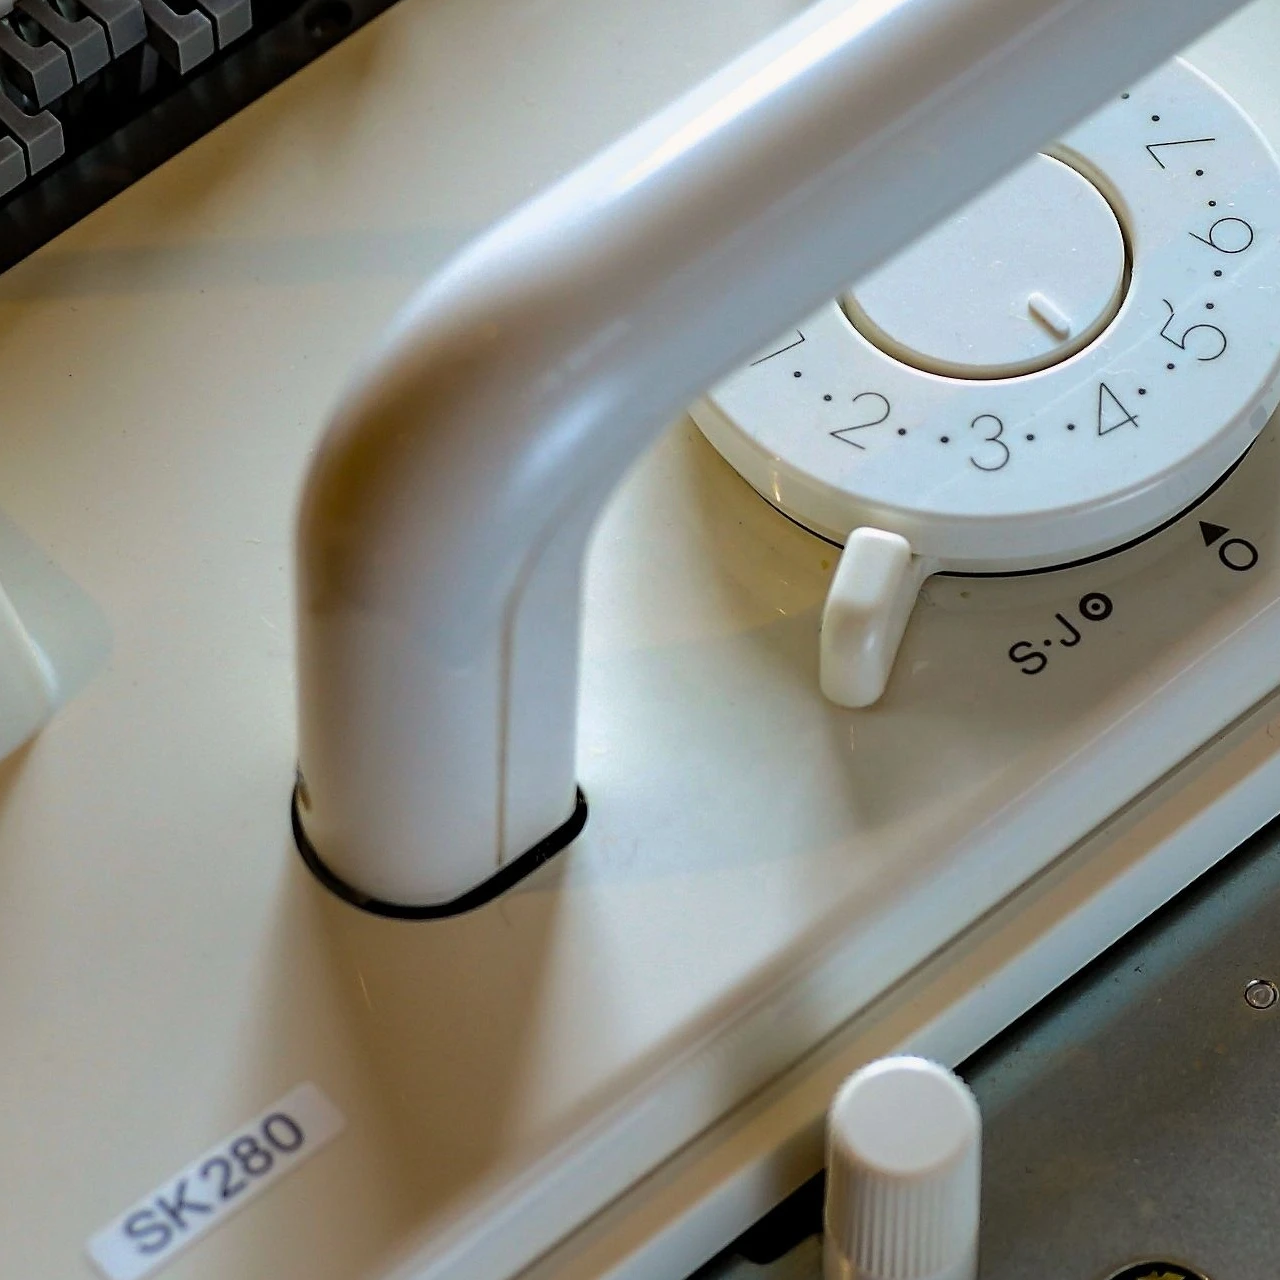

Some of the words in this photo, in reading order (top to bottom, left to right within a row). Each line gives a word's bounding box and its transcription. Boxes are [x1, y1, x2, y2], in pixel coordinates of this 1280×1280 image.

[1145, 137, 1216, 169] 7
[1189, 216, 1254, 254] 6
[1159, 299, 1228, 363] 5
[828, 391, 891, 450] 2
[1096, 381, 1139, 438] 4
[969, 413, 1010, 472] 3
